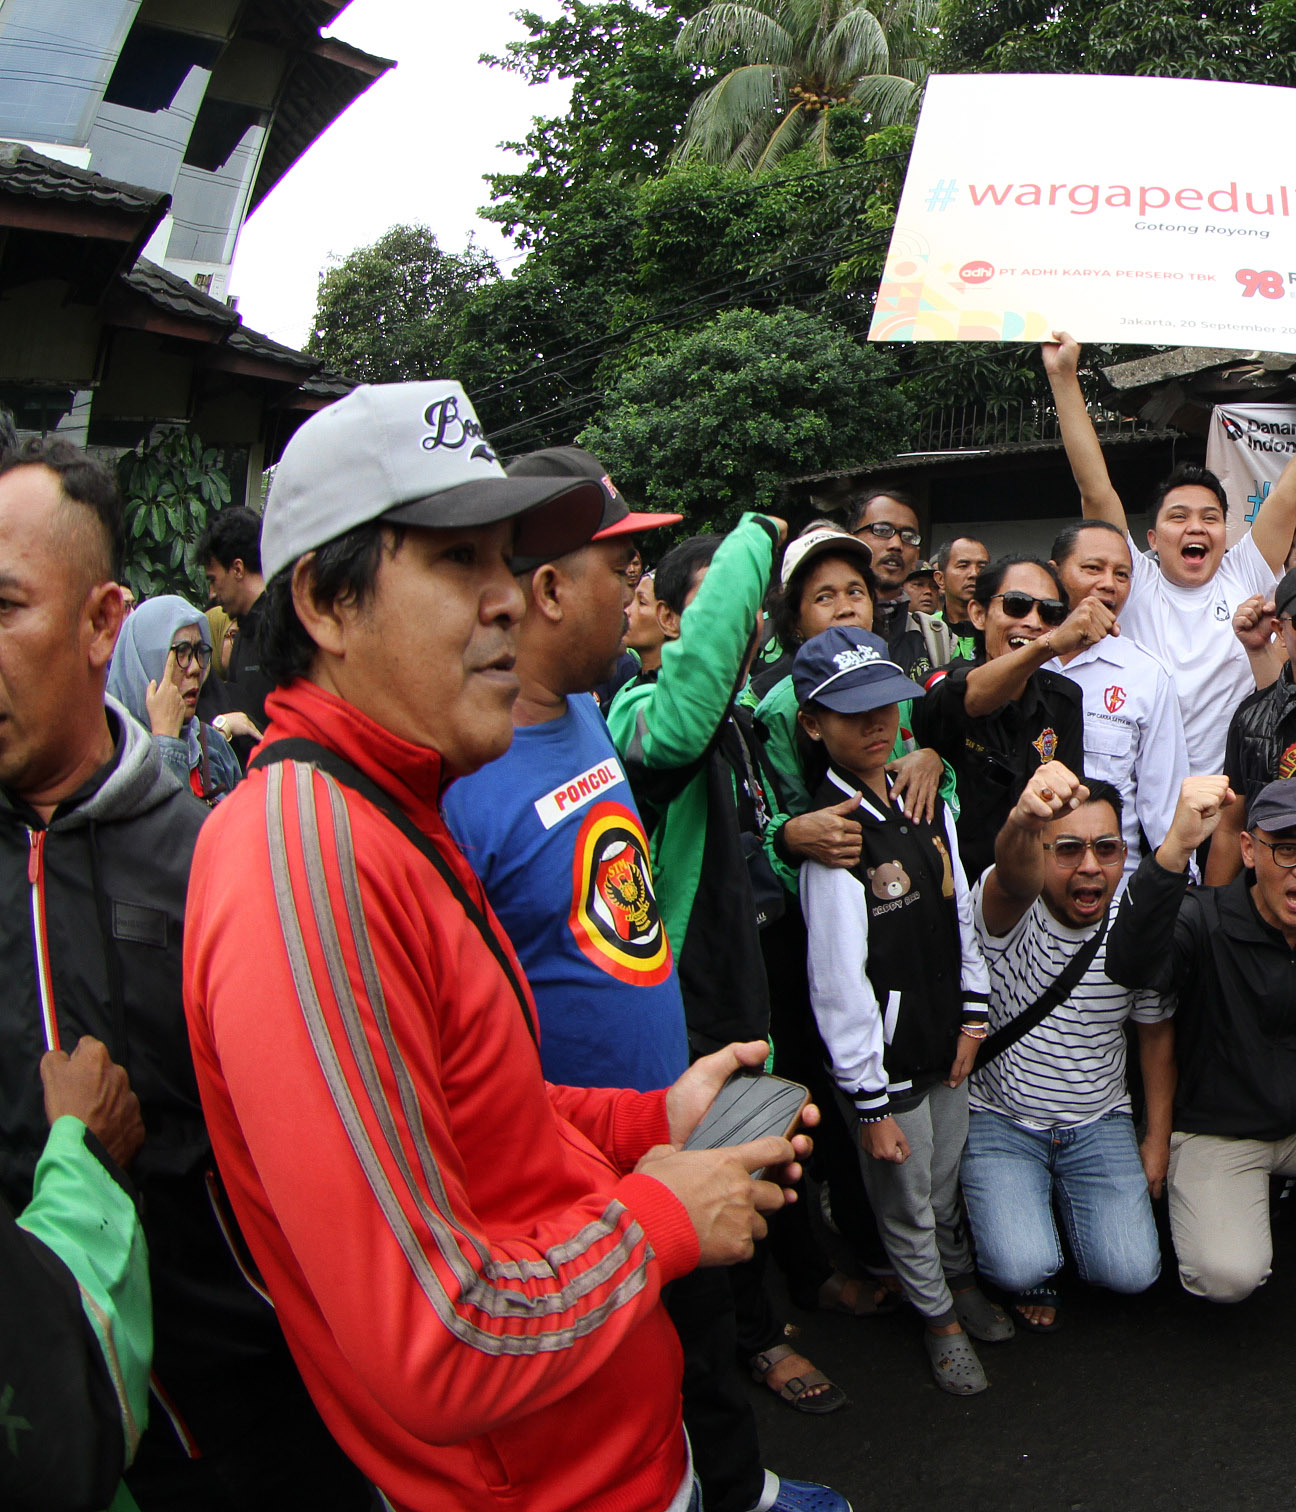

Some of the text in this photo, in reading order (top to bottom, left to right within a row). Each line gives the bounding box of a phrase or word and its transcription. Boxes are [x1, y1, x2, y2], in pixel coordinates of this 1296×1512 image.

[1134, 221, 1270, 239] Gotong Royong
[961, 266, 1216, 282] adhi PT ADHI KARYA PERSERO TBK
[1235, 268, 1285, 299] 98
[1180, 320, 1196, 328] 20
[1201, 321, 1276, 334] September
[554, 765, 616, 812] PONCOL
